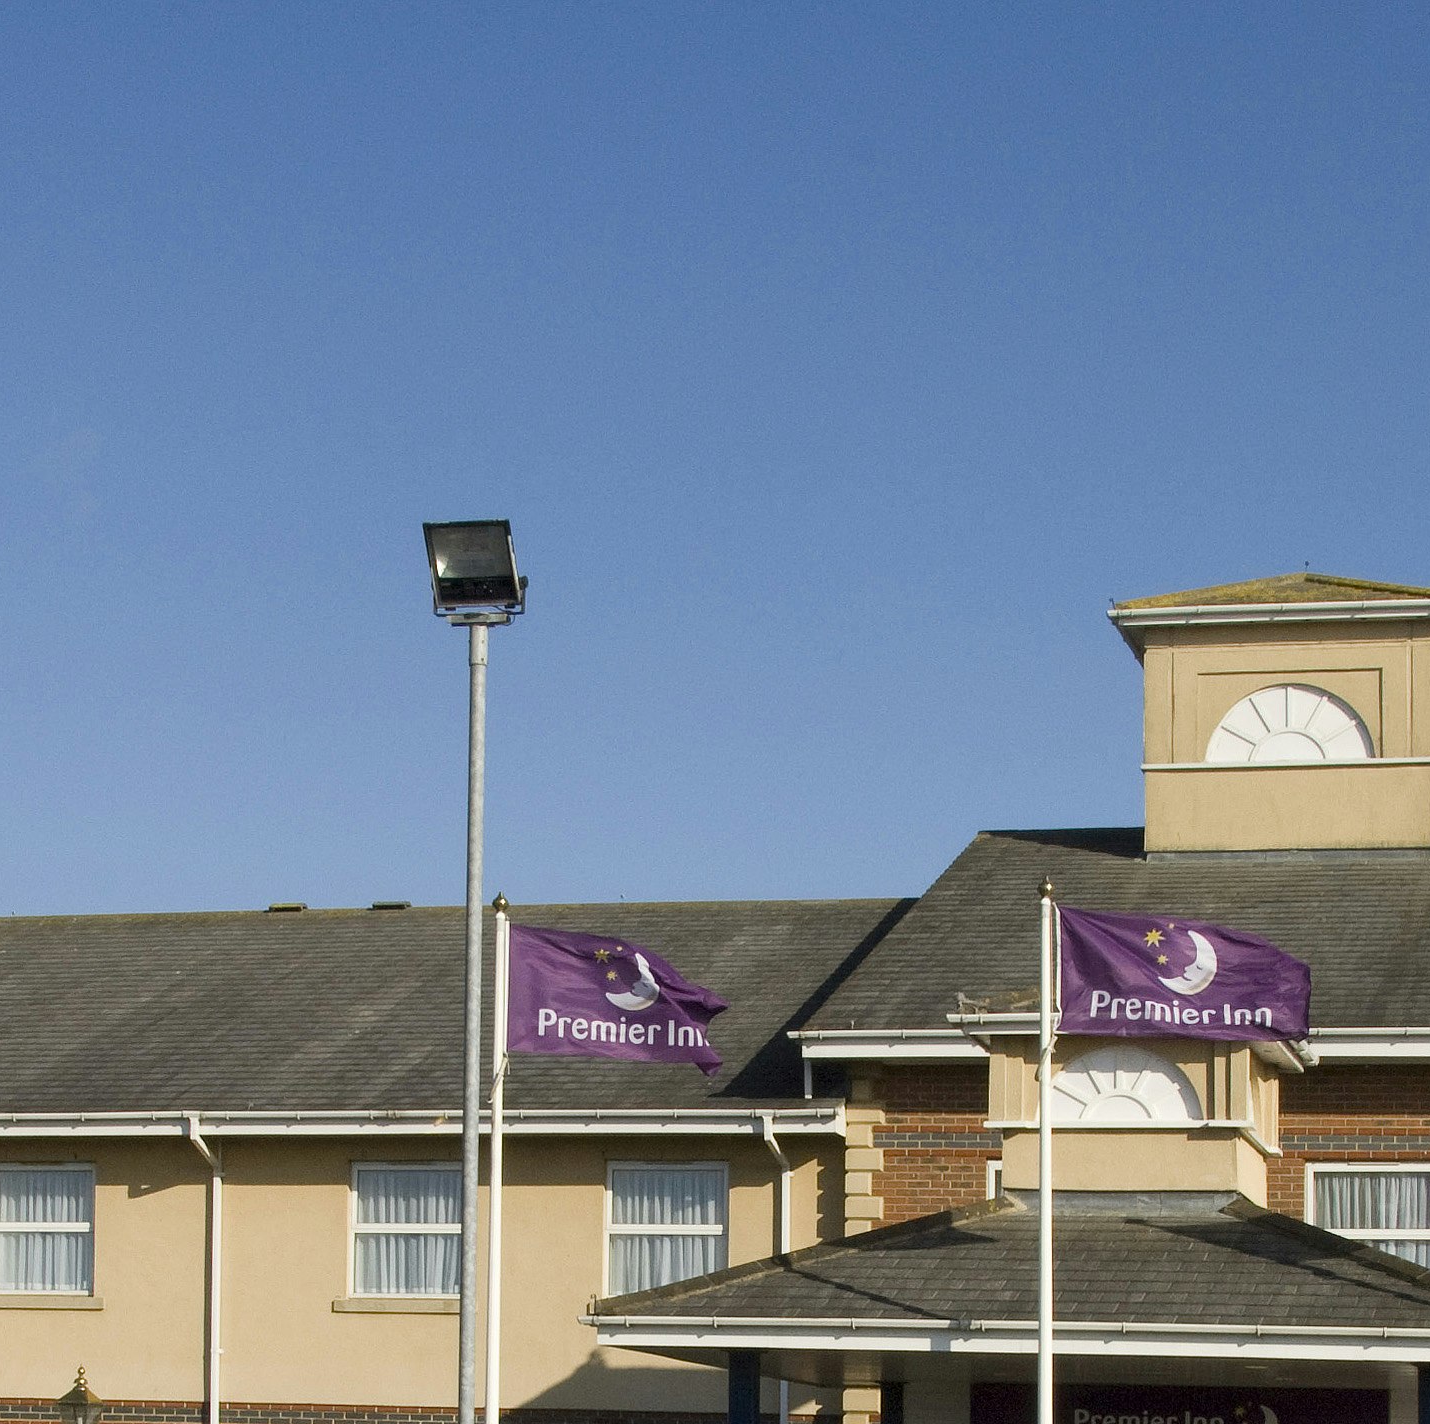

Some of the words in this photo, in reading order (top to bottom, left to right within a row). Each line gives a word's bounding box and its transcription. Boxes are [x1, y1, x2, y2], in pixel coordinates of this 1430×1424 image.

[538, 1008, 662, 1045] Premier
[1090, 990, 1216, 1025] Premier
[1223, 1003, 1272, 1028] Inn
